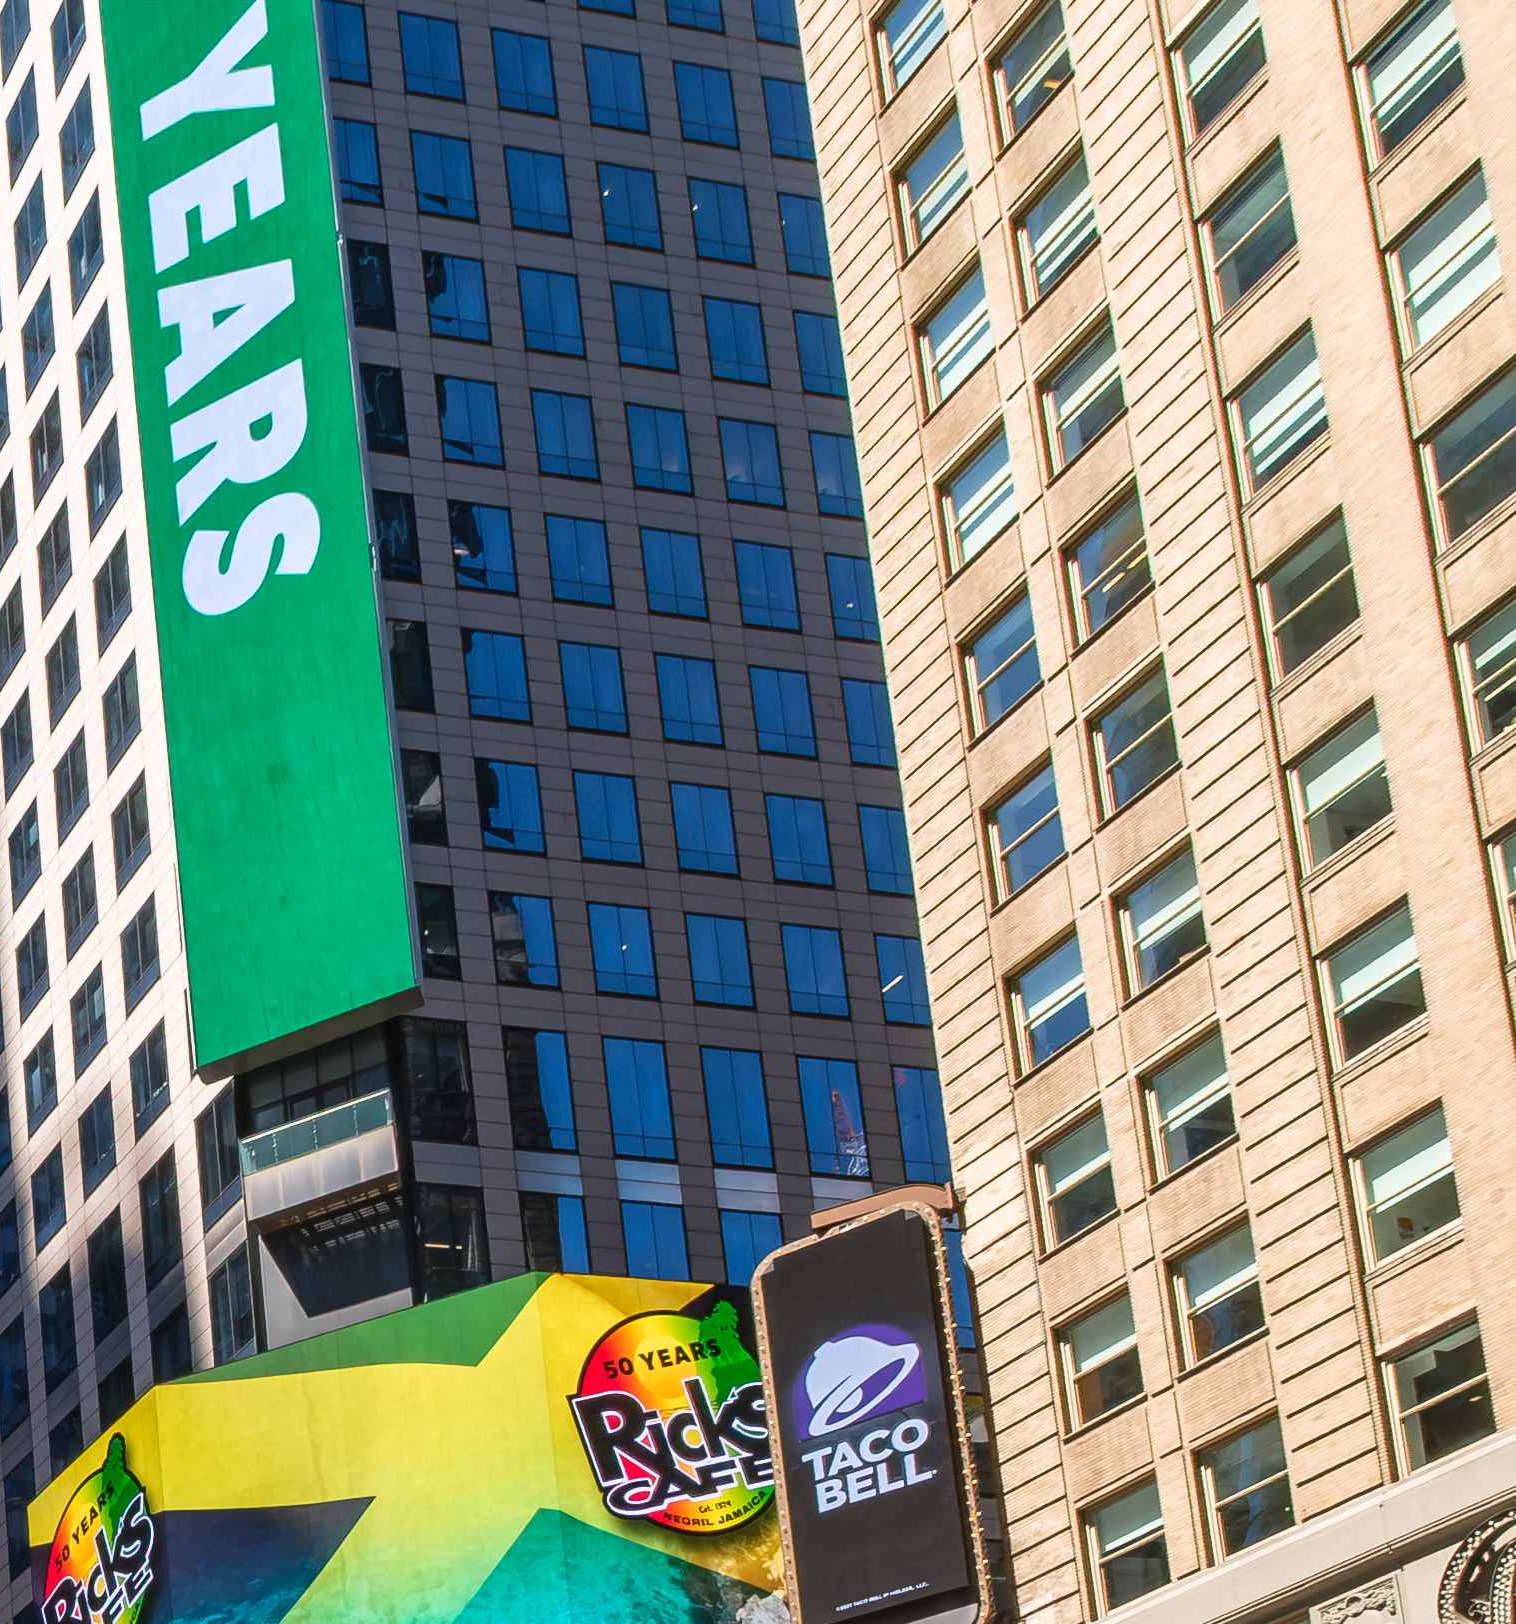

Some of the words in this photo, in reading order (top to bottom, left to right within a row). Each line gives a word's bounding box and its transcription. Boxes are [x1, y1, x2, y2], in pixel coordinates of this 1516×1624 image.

[140, 0, 321, 617] YEARS
[602, 1357, 634, 1379] 50
[638, 1338, 722, 1371] YEARS
[802, 1418, 929, 1481] TACO
[72, 1479, 115, 1542] YEARS
[814, 1464, 933, 1515] BELL
